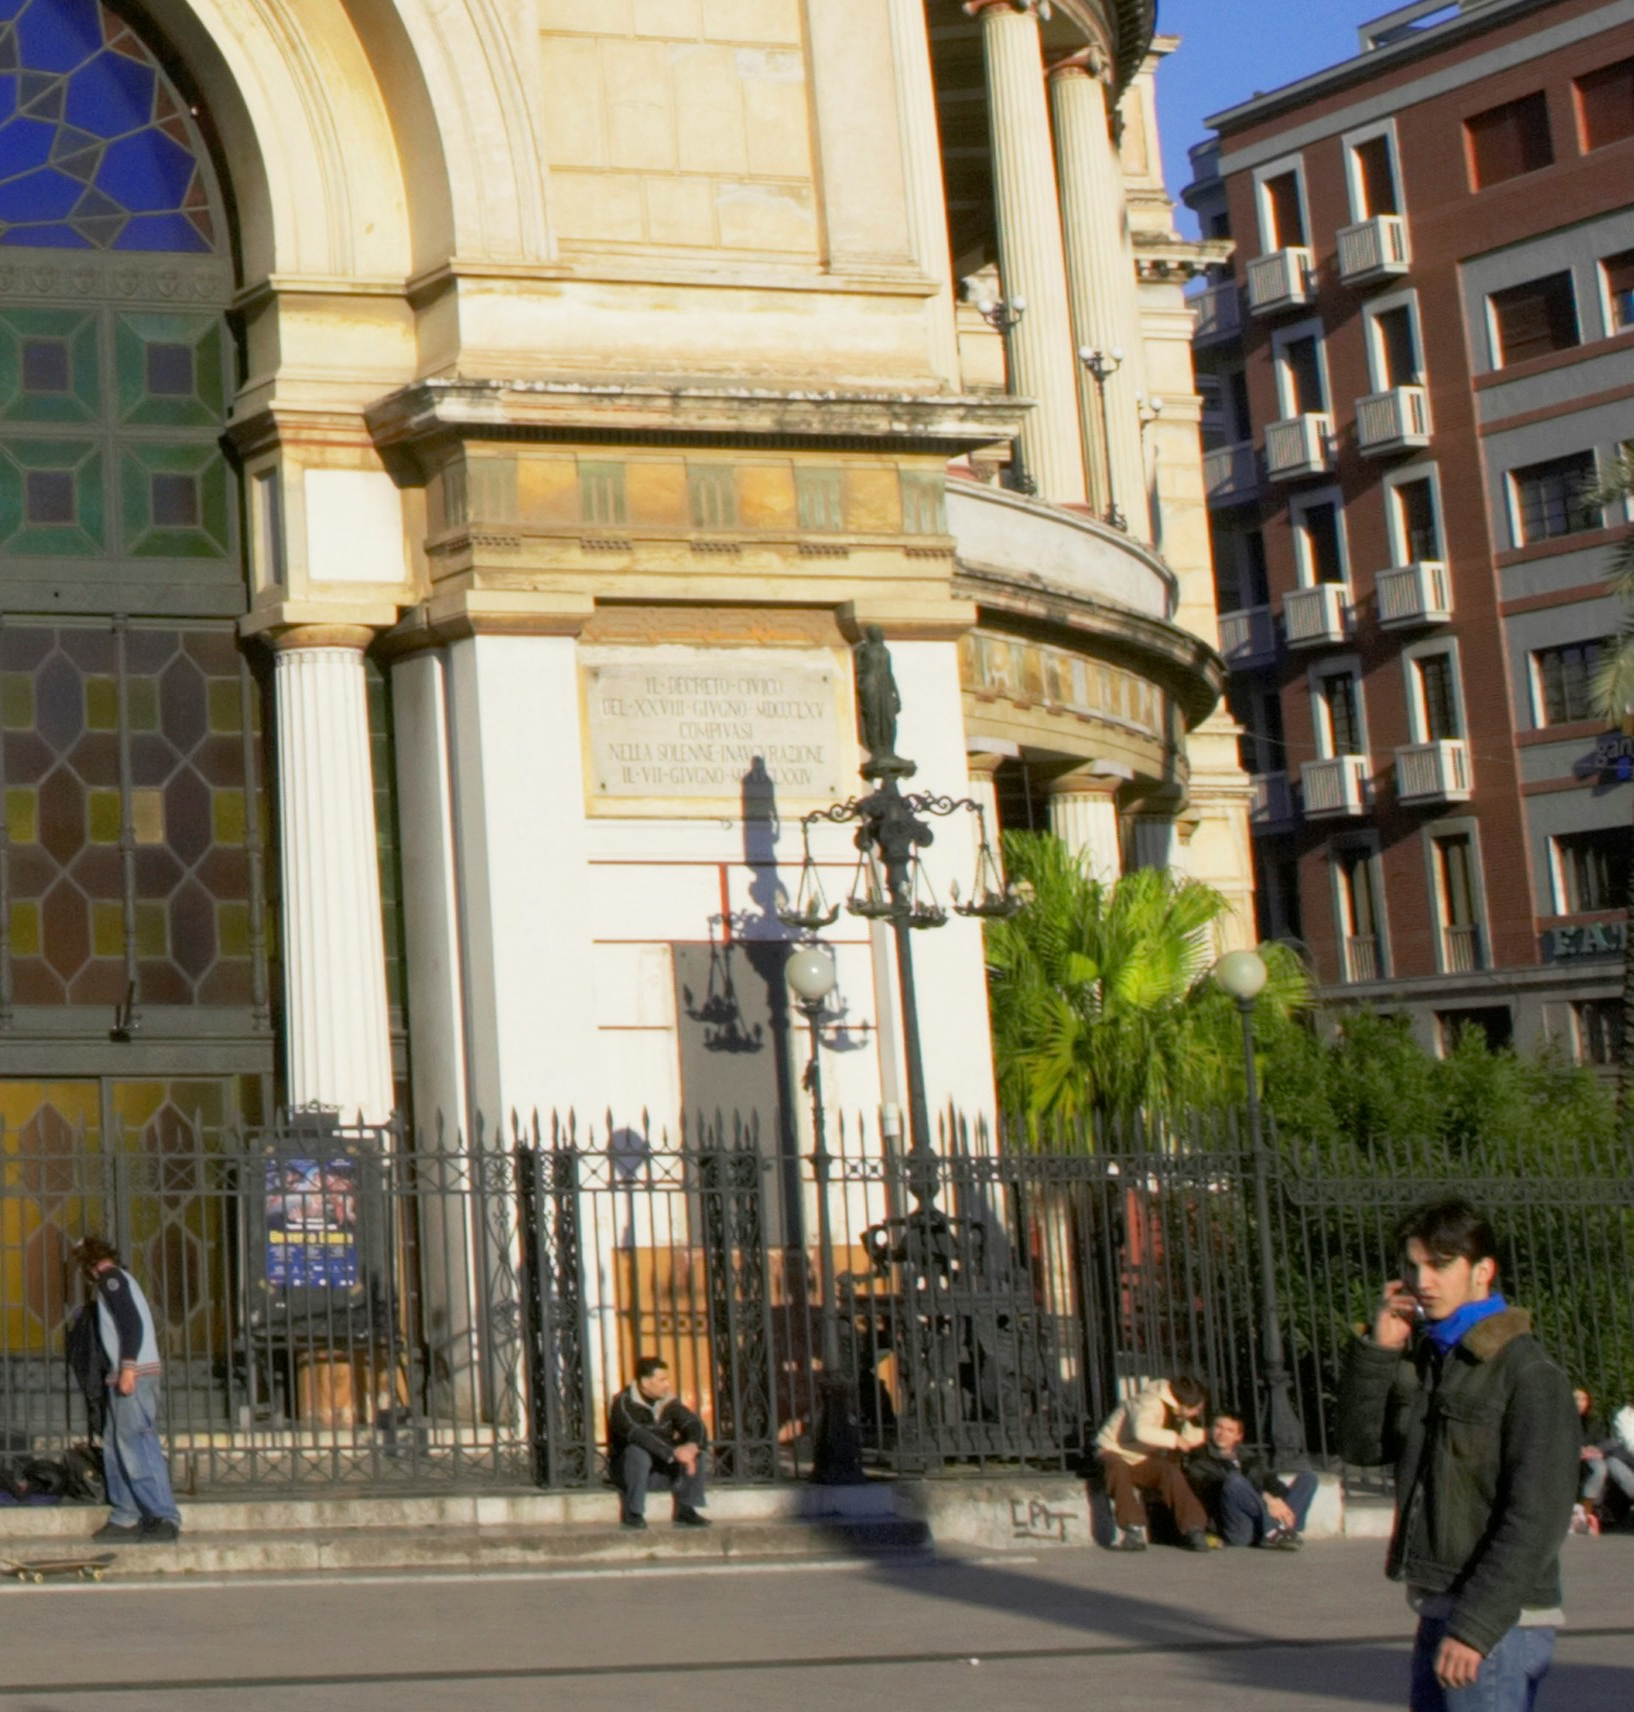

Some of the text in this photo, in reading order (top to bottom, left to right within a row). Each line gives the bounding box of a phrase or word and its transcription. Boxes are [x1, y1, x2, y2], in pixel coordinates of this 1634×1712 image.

[645, 676, 783, 696] IL DECRETO CIVICO
[602, 698, 627, 716] DEL
[679, 722, 754, 740] COMPIVASI
[608, 743, 652, 762] NELLA
[656, 743, 714, 763] SOLENNE
[622, 767, 634, 784] IL
[641, 767, 662, 784] VII
